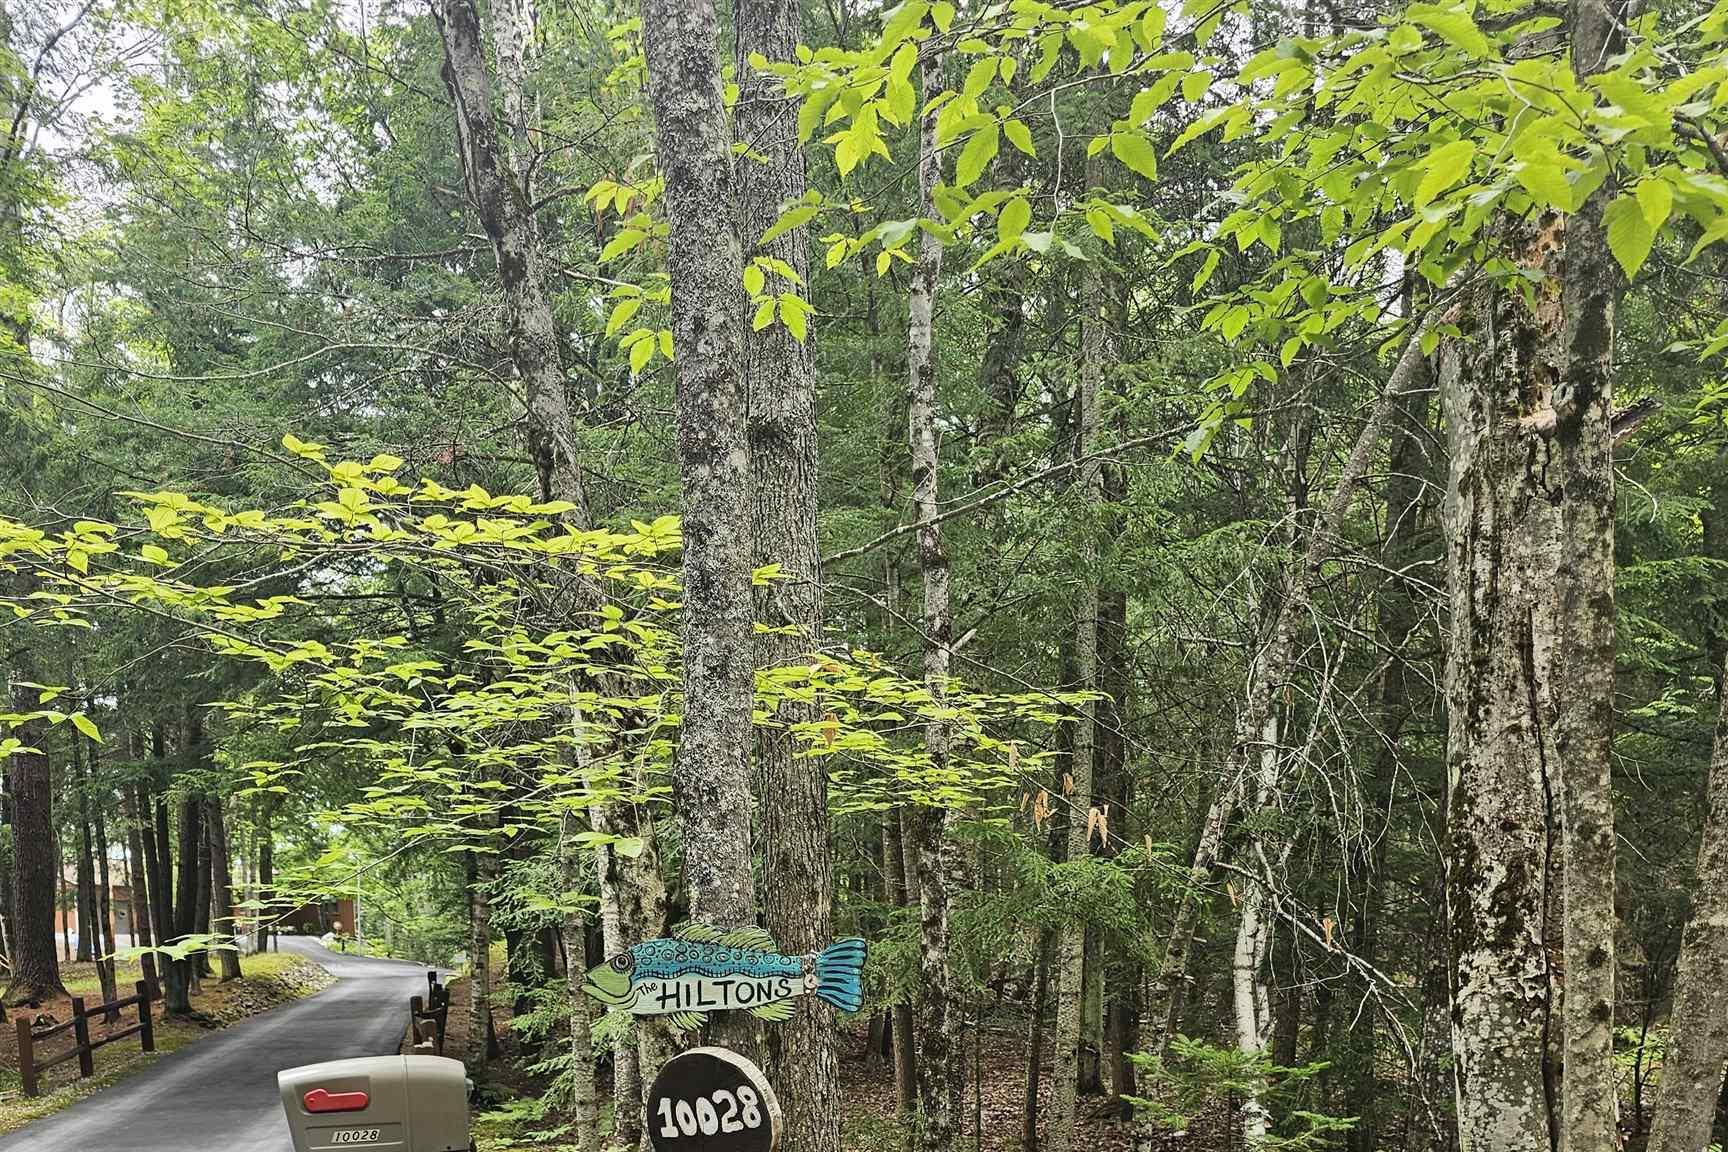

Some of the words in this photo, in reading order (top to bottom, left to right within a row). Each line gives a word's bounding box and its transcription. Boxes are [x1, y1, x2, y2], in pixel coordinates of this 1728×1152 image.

[636, 981, 659, 997] The
[655, 978, 793, 1010] HILTONS
[656, 1085, 763, 1138] 10028
[334, 1129, 378, 1143] 10028
